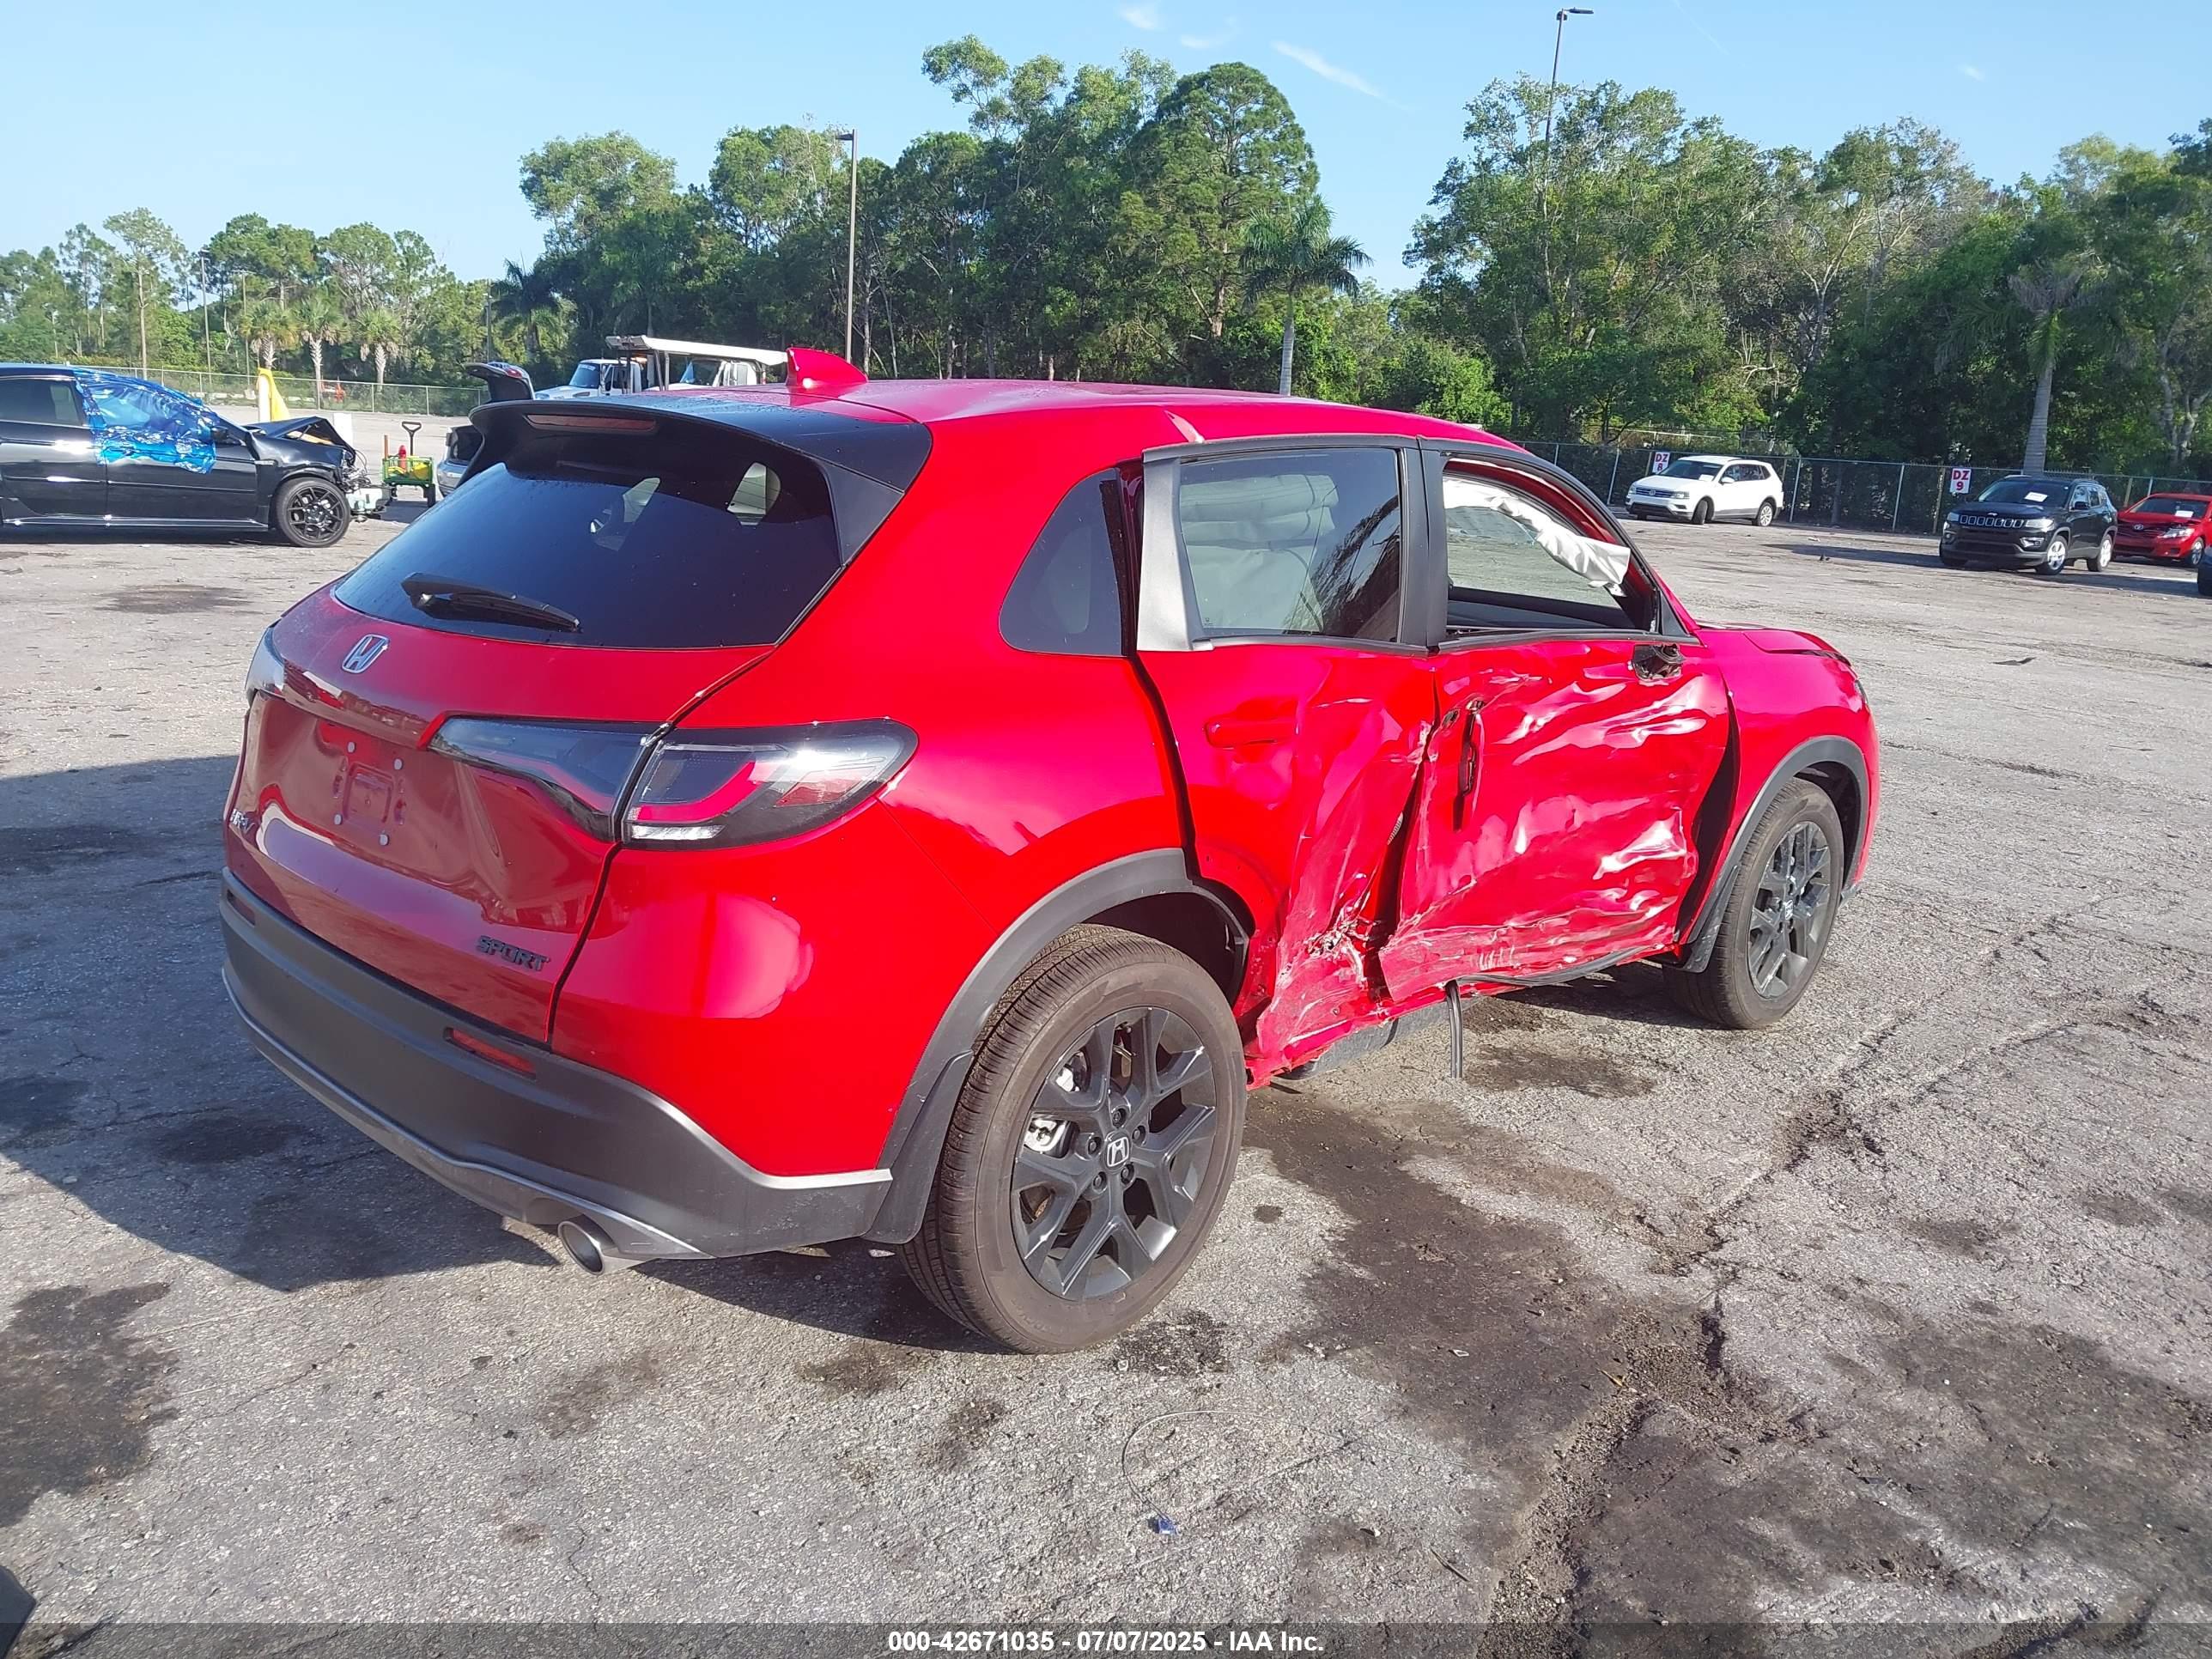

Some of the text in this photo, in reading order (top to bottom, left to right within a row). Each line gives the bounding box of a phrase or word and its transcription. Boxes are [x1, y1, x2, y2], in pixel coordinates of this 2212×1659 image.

[1656, 453, 1668, 463] DZ
[1657, 463, 1663, 471] 8
[1953, 470, 1970, 481] DZ
[1956, 481, 1964, 491] 9
[477, 935, 550, 971] SPORT
